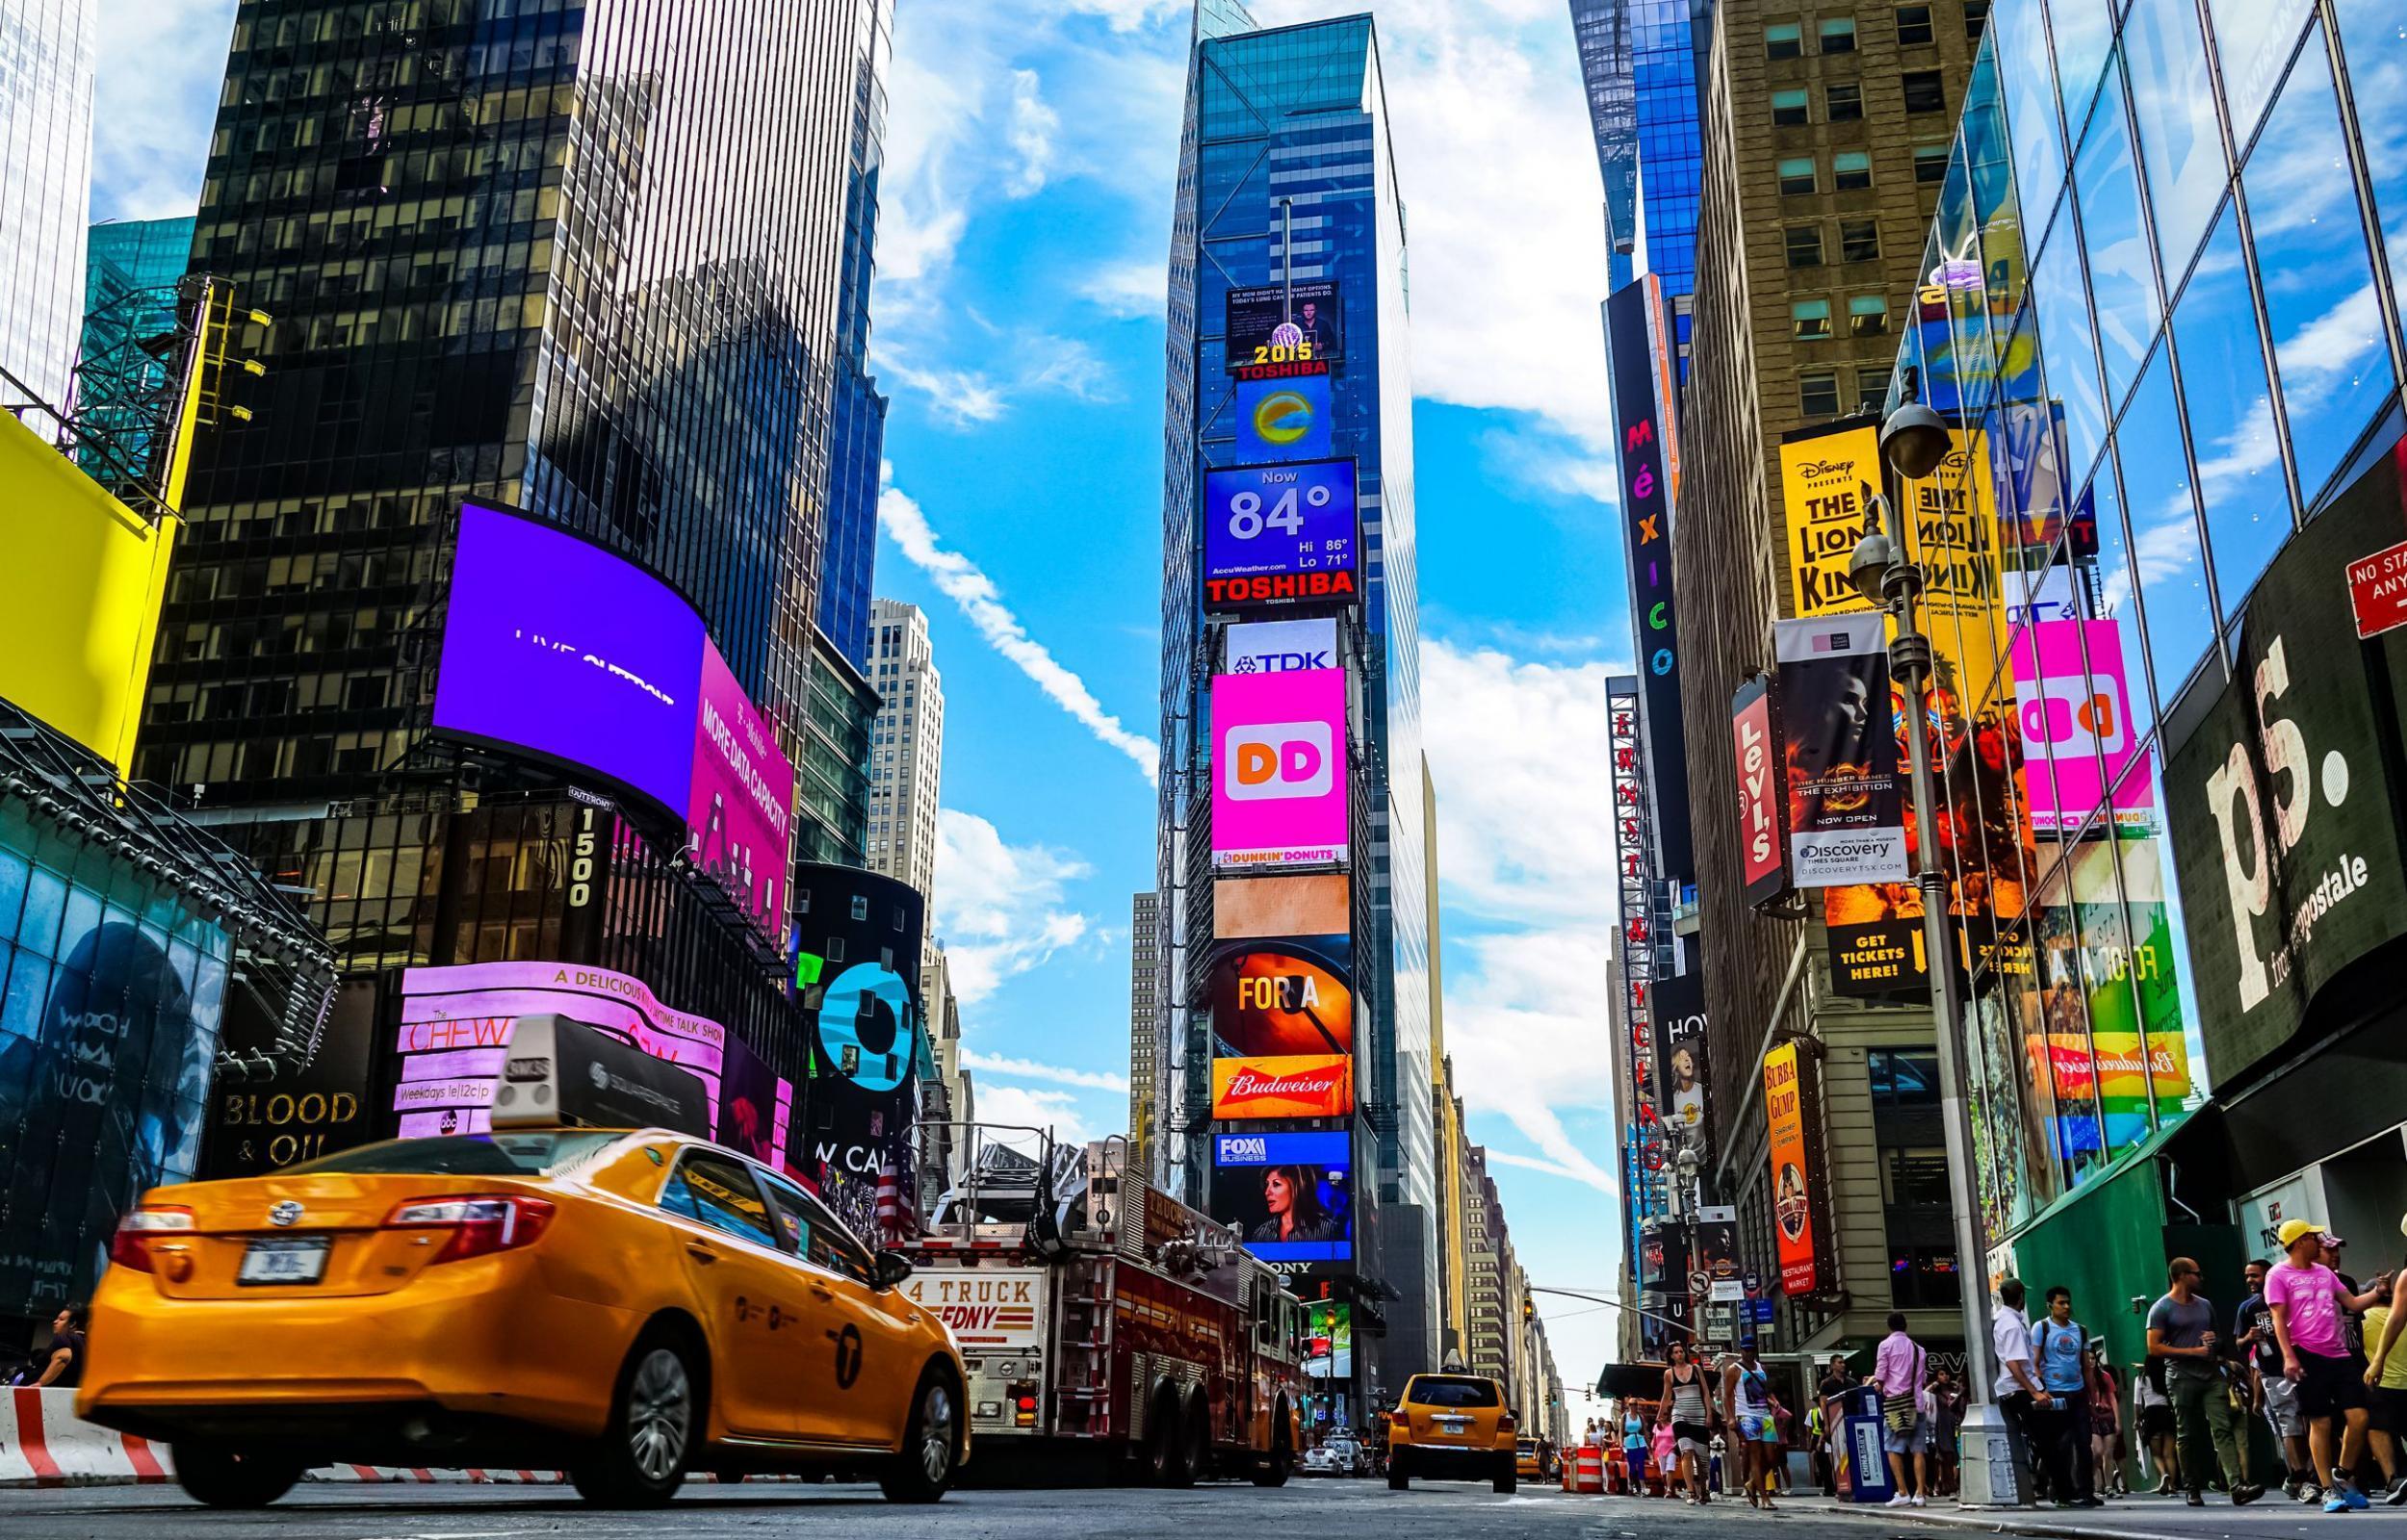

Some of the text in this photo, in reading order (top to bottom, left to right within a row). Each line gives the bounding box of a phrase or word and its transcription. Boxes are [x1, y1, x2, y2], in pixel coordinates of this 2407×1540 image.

[1255, 342, 1312, 364] 2015
[1238, 361, 1327, 379] TOSHIBA
[1262, 471, 1297, 484] Now
[1797, 460, 1854, 479] Disney
[1807, 475, 1853, 489] PRESENTS
[1805, 492, 1856, 520] THE
[1299, 540, 1313, 552] Hi
[1212, 563, 1287, 575] AccuWeather.com
[1299, 555, 1317, 568] Lo
[2356, 564, 2377, 584] NO
[1207, 571, 1354, 603] TOSHIBA
[1799, 566, 1860, 611] KIN
[2373, 573, 2407, 600] ANY
[1255, 651, 1329, 673] TDK
[703, 698, 787, 838] MORE DATA CAPACITY
[1237, 740, 1321, 784] DD
[1798, 779, 1815, 787] THE
[1798, 782, 1893, 797] THE EXHIBITION
[571, 789, 611, 810] OUTFRONT
[1742, 721, 1771, 864] Levi's
[1817, 814, 1877, 826] NOW OPEN
[570, 808, 595, 908] 1500
[1232, 849, 1333, 864] DUNKIN' DONUTS
[1802, 841, 1889, 859] Discovery
[1802, 863, 1902, 875] DISCOVERYTSX.COM
[1856, 935, 1887, 948] GET
[1841, 947, 1905, 963] TICKETS
[1851, 964, 1899, 981] HERE!
[555, 969, 568, 984] A
[576, 971, 641, 1001] DELICIOUS
[677, 1017, 699, 1035] TALK
[1239, 975, 1319, 1011] FOR A
[434, 1010, 447, 1020] The
[409, 1017, 509, 1051] CHEW
[1765, 1059, 1796, 1091] BUBBA
[401, 1085, 445, 1101] Weekdays
[1227, 1074, 1334, 1096] Budweiser
[224, 1092, 358, 1126] BLOOD
[1771, 1090, 1796, 1119] GUMP
[440, 1115, 457, 1129] abc
[1221, 1139, 1259, 1155] FOX
[1272, 1262, 1312, 1274] ONY
[1782, 1263, 1814, 1278] RESTAURANT
[909, 1281, 1031, 1302] 4 TRUCK
[1788, 1277, 1809, 1289] MARKET
[943, 1306, 998, 1329] FDNY
